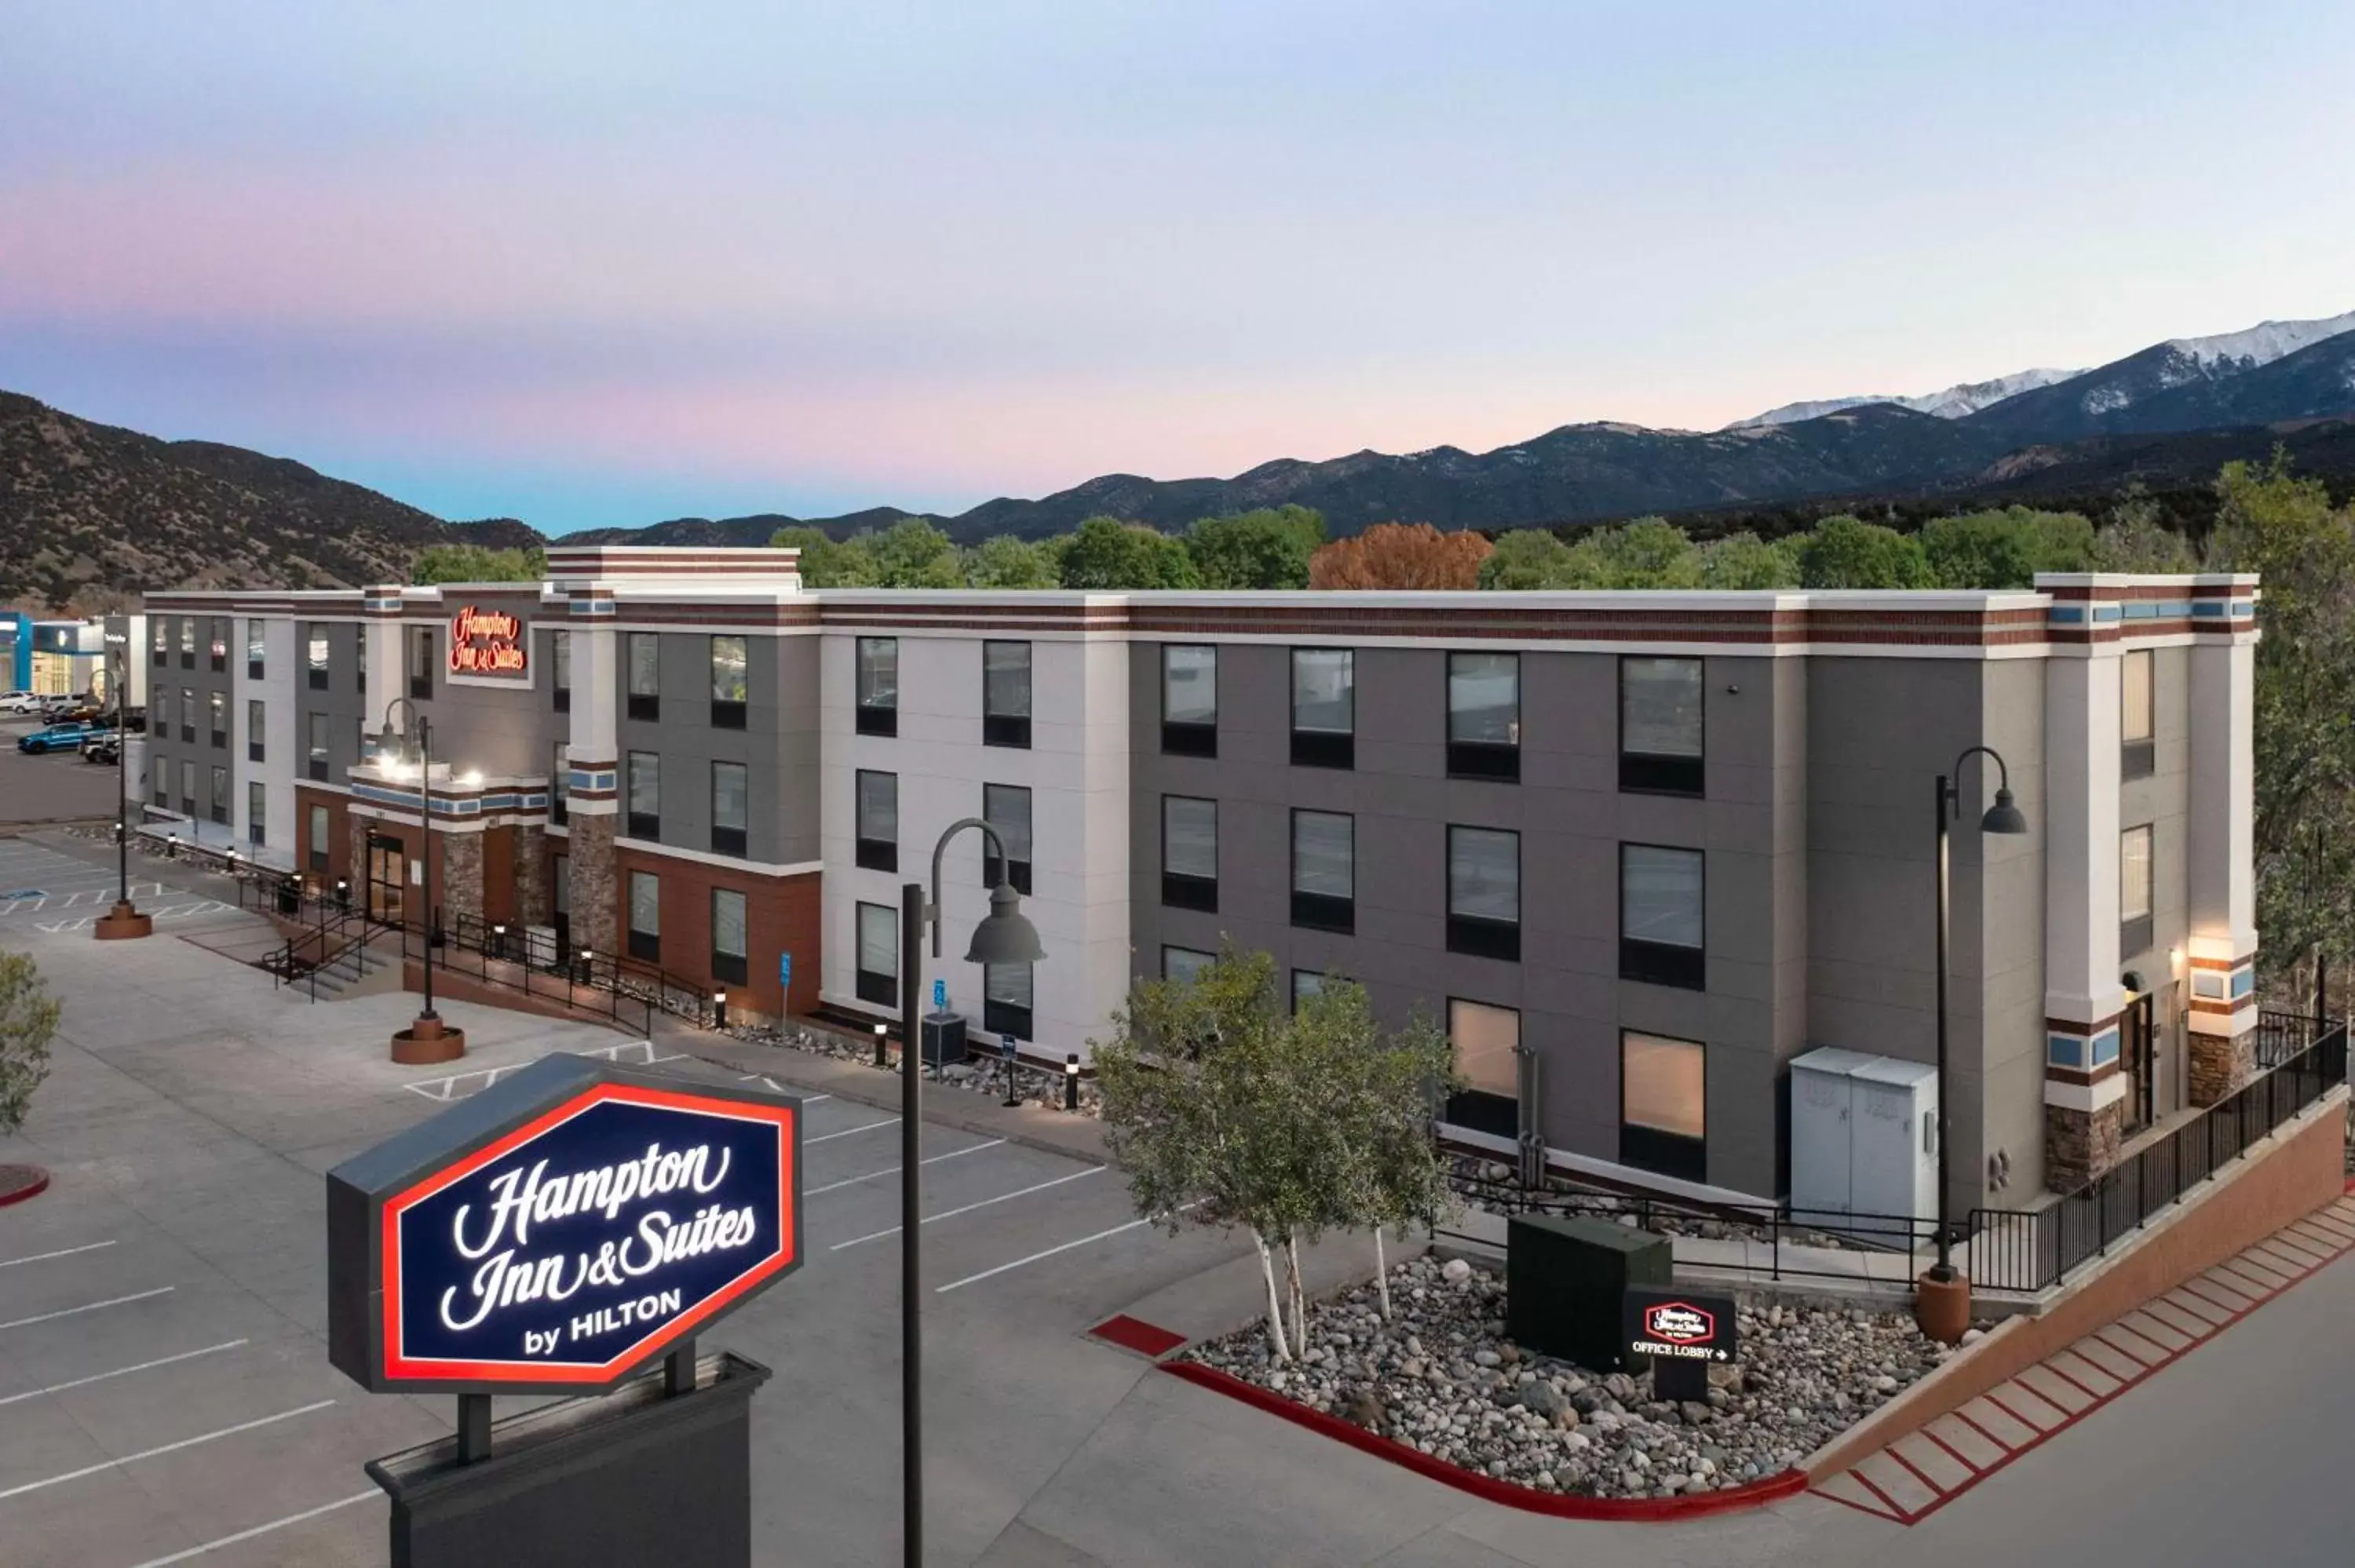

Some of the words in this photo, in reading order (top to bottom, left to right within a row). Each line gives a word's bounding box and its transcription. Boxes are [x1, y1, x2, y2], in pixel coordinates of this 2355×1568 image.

[453, 605, 518, 641] Hampton
[450, 641, 480, 670] Inn
[488, 641, 524, 669] Suites
[454, 1143, 731, 1259] Hampton
[440, 1249, 588, 1331] Inn
[589, 1242, 623, 1285] &
[619, 1205, 756, 1276] Suites
[524, 1328, 560, 1355] by
[571, 1288, 682, 1342] HILTON
[1632, 1341, 1672, 1355] OFFICE
[1674, 1345, 1714, 1358] LOBBY
